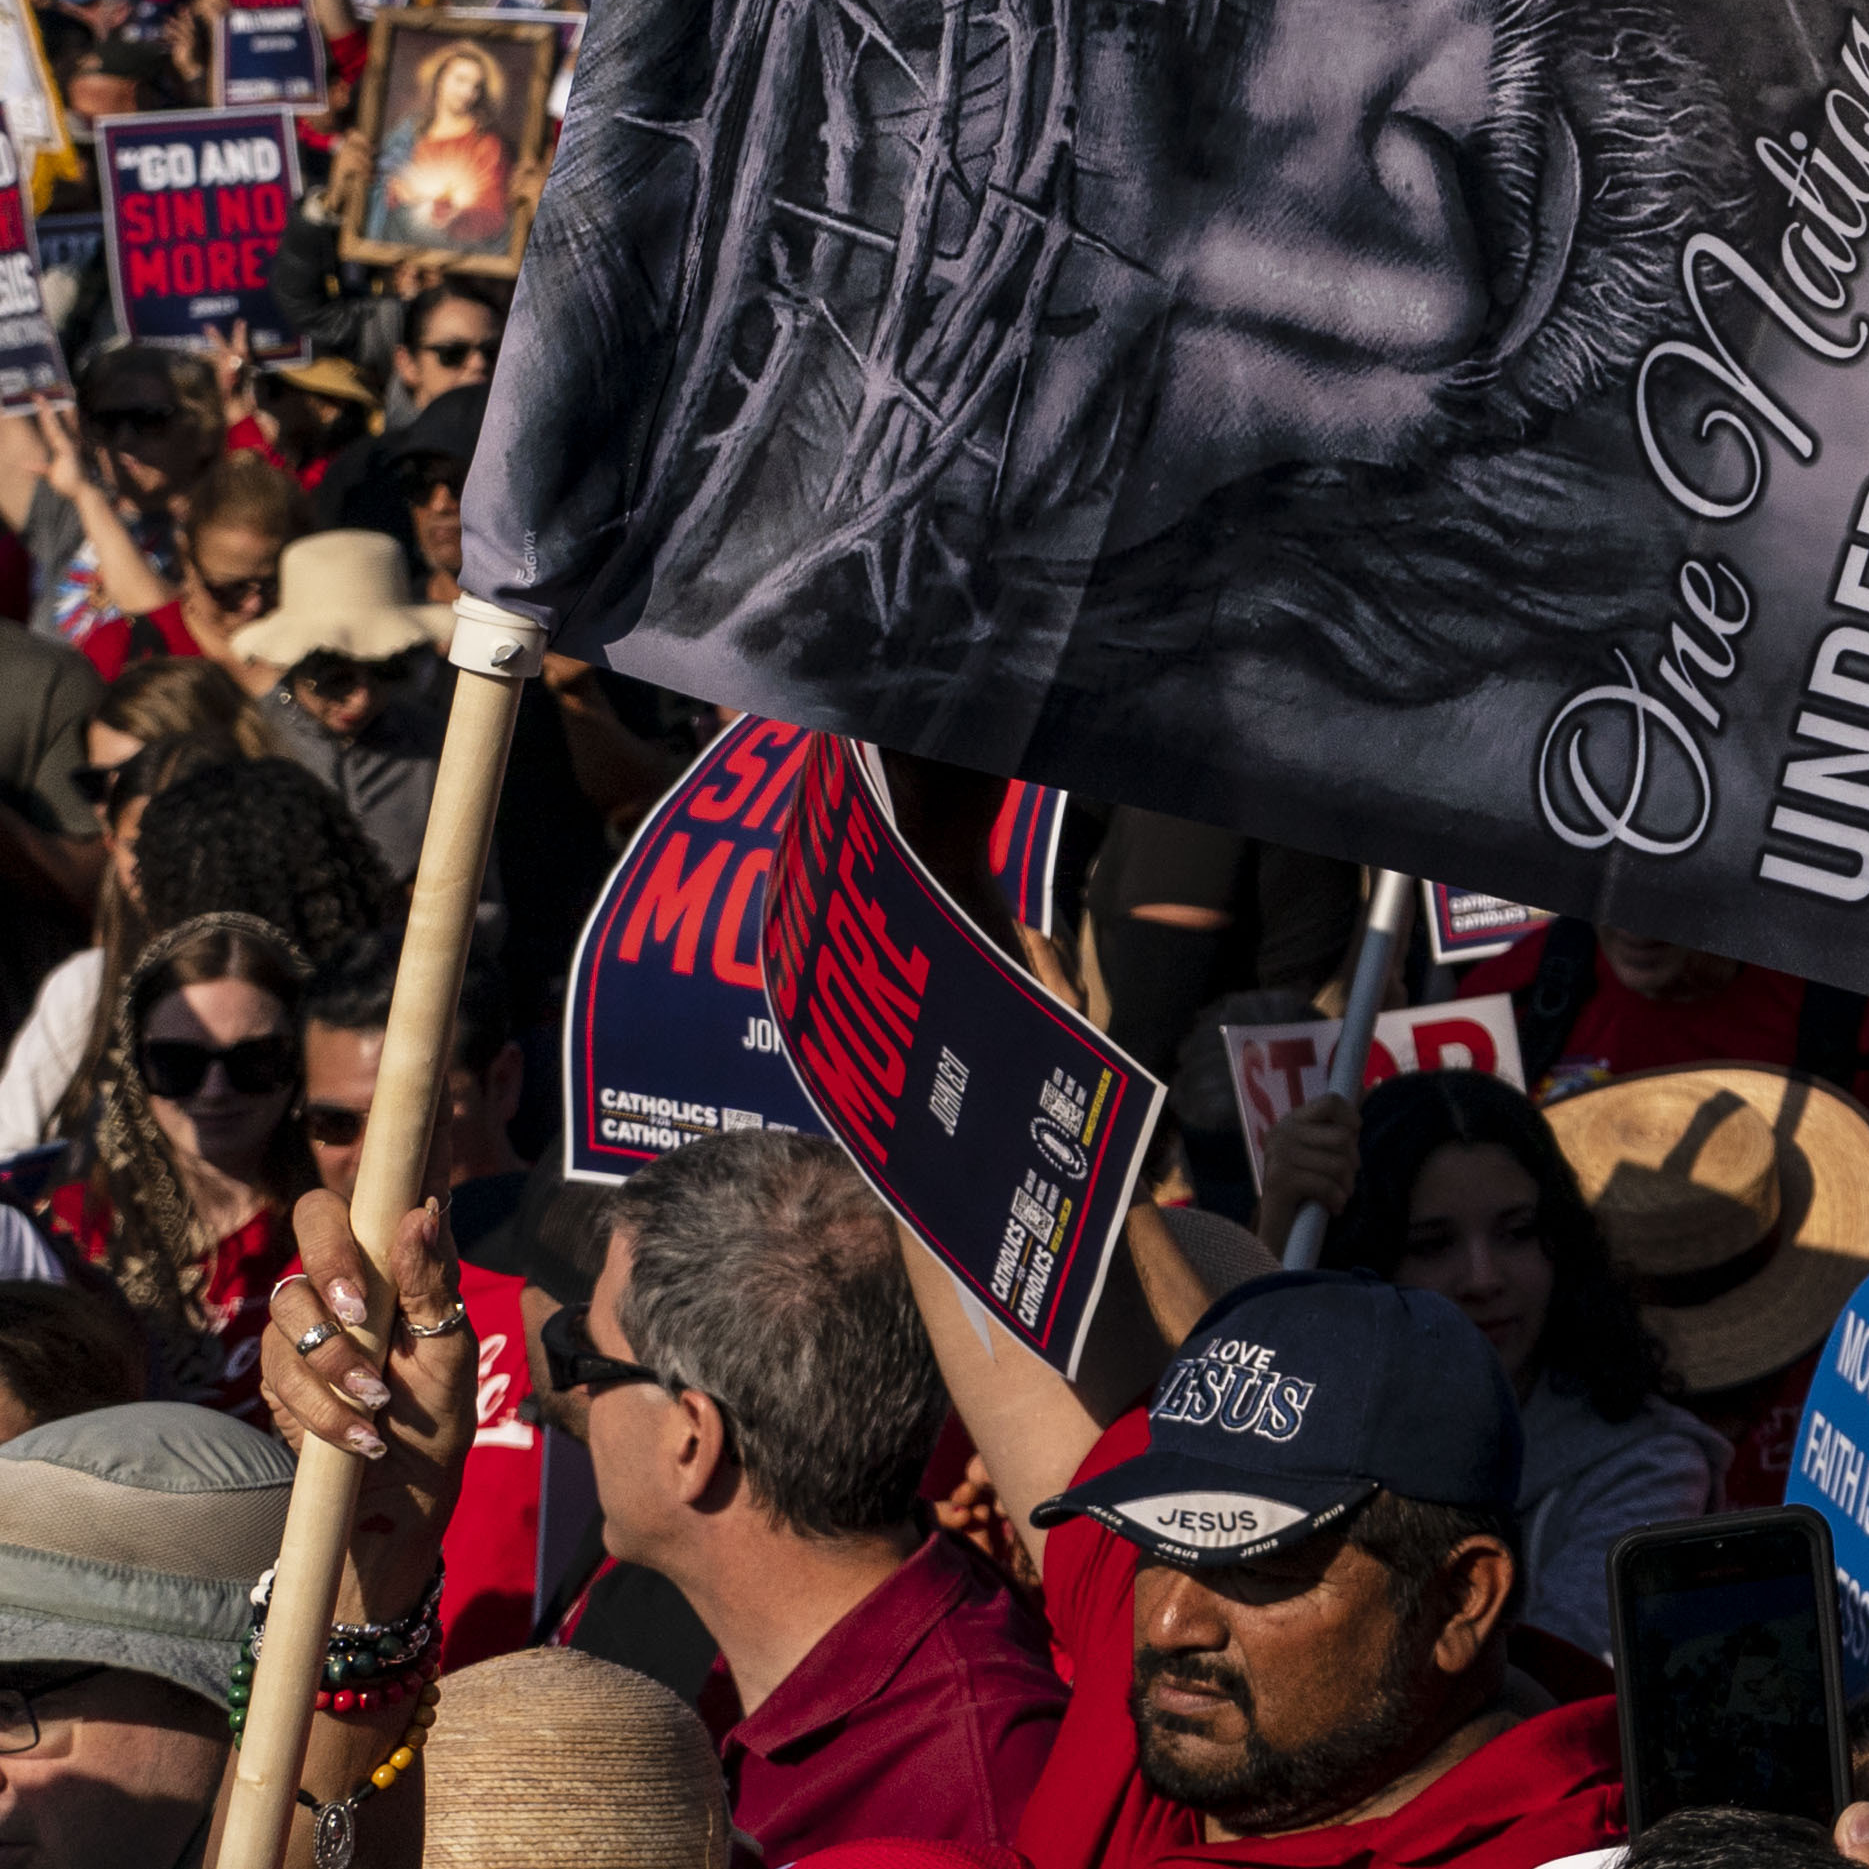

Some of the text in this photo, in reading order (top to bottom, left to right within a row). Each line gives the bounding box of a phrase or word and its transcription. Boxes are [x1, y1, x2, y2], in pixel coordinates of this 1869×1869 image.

[115, 137, 282, 191] “GO AND
[121, 183, 287, 244] SIN NO
[1538, 558, 1751, 856] One
[600, 1087, 720, 1128] CATHOLICS
[929, 1045, 970, 1137] JOHN 8:11
[990, 1218, 1027, 1303] CATHOLICS
[1017, 1244, 1055, 1329] CATHOLICS
[1150, 1358, 1317, 1443] ESUS
[1801, 1409, 1867, 1518] FAITH
[1087, 1503, 1347, 1561] JESUS JESUS JESUS JESUS
[1157, 1507, 1259, 1533] JESUS
